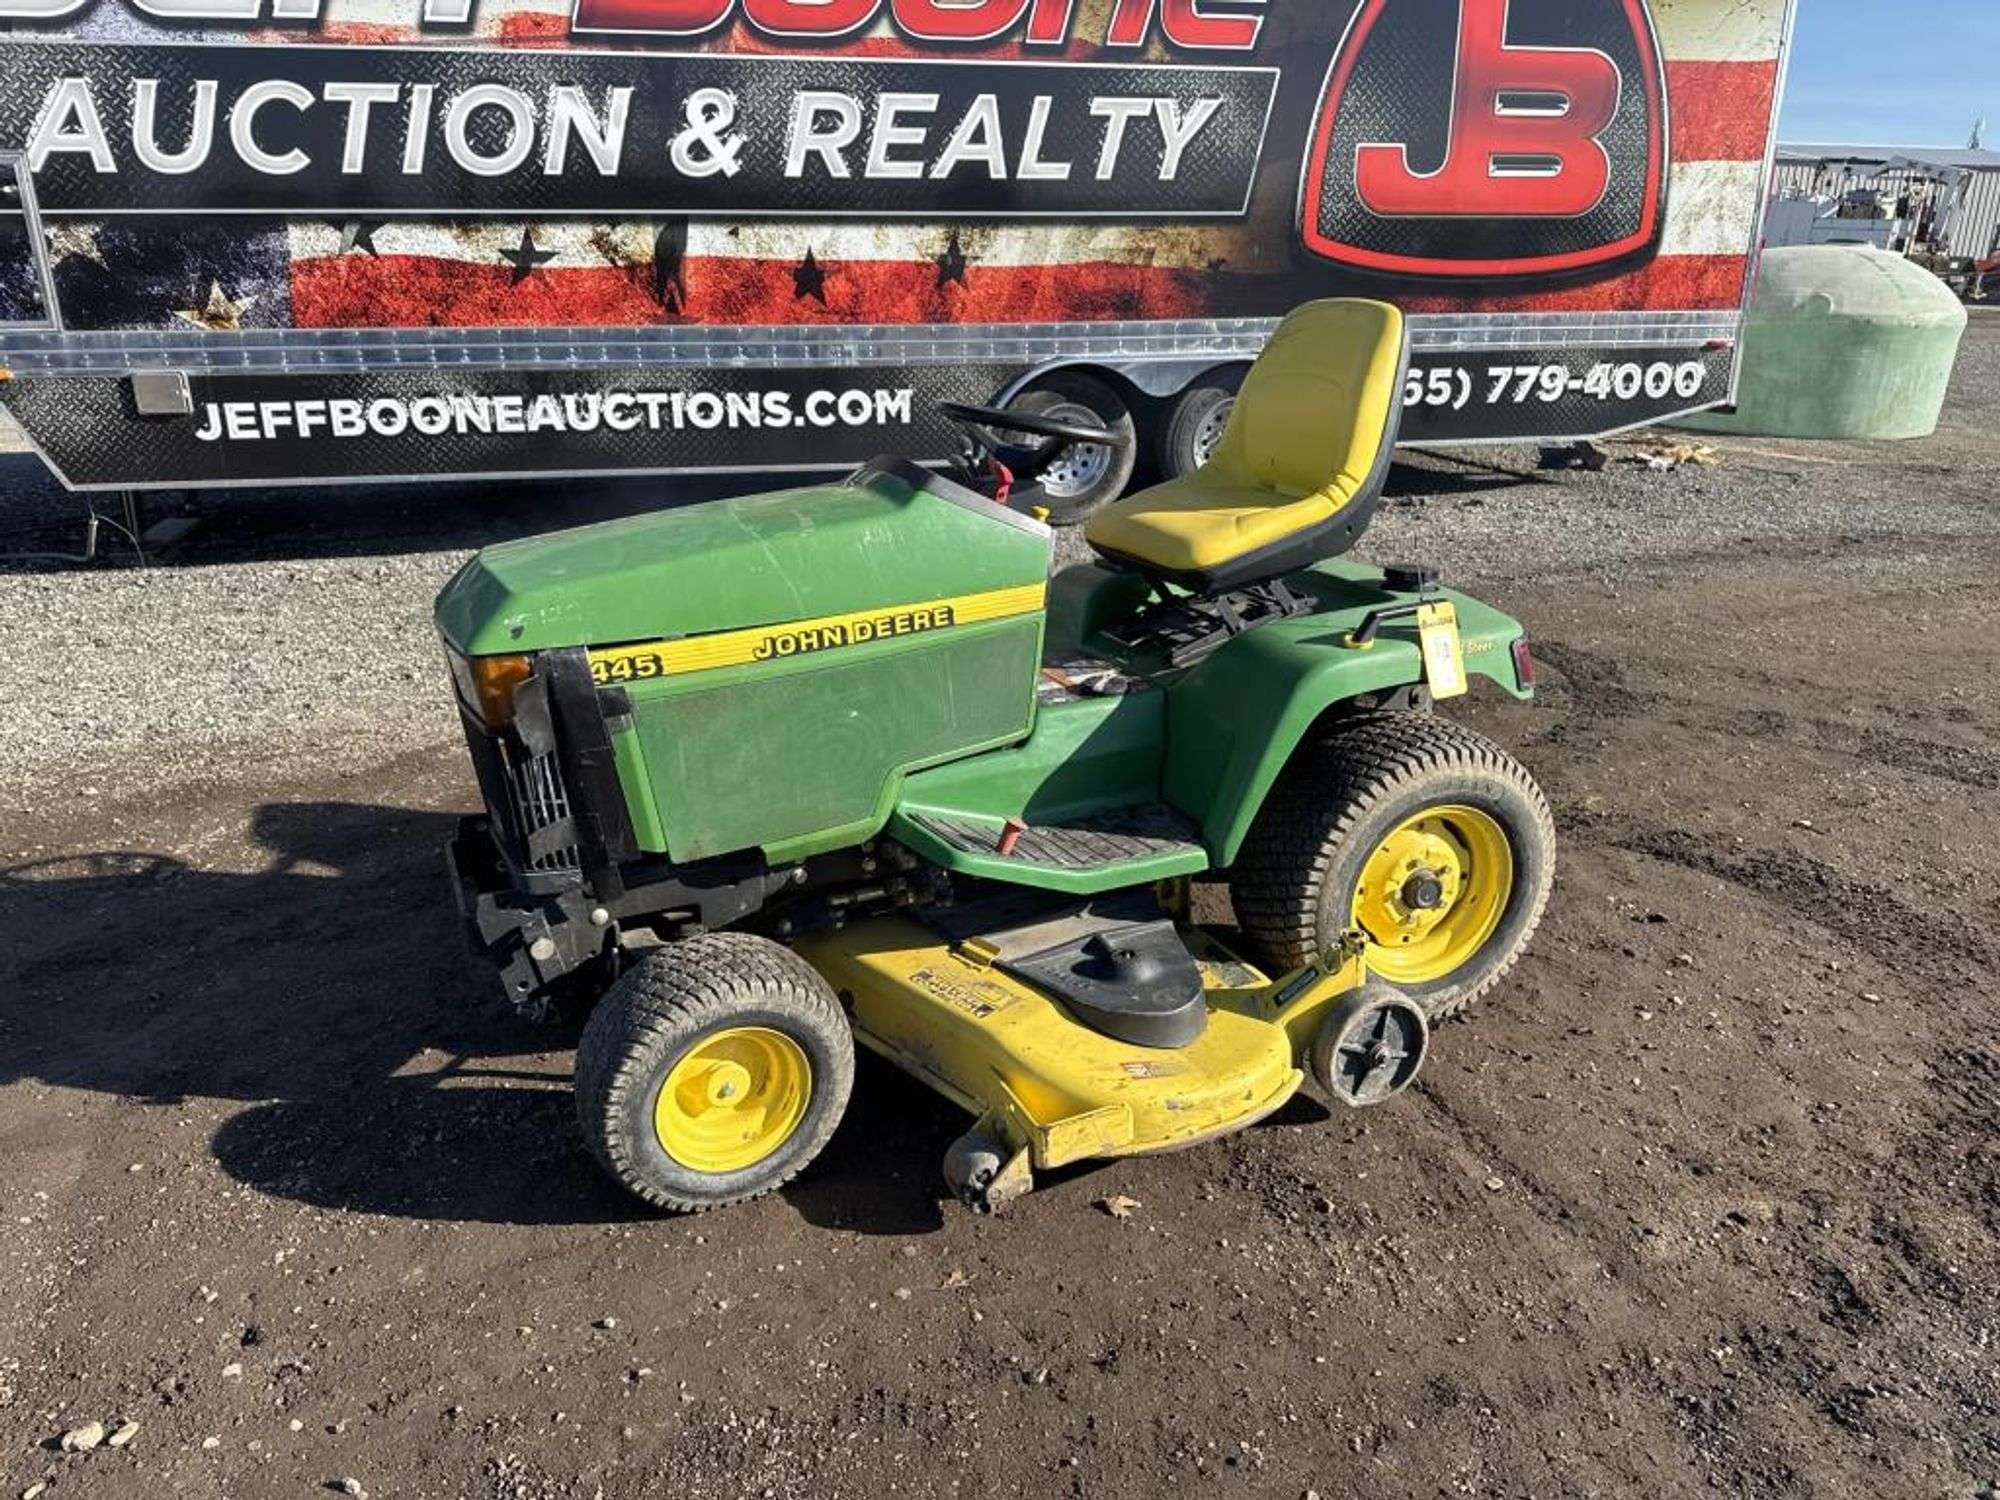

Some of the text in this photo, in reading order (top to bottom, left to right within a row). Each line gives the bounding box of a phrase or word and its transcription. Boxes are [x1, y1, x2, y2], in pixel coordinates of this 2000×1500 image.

[27, 77, 1223, 181] AUCTION & REALTY
[1486, 361, 1705, 404] 779-4000
[195, 388, 914, 442] JEFFBOONEAUCTIONS.COM
[753, 605, 957, 662] JOHN DEERE
[590, 653, 665, 687] 445
